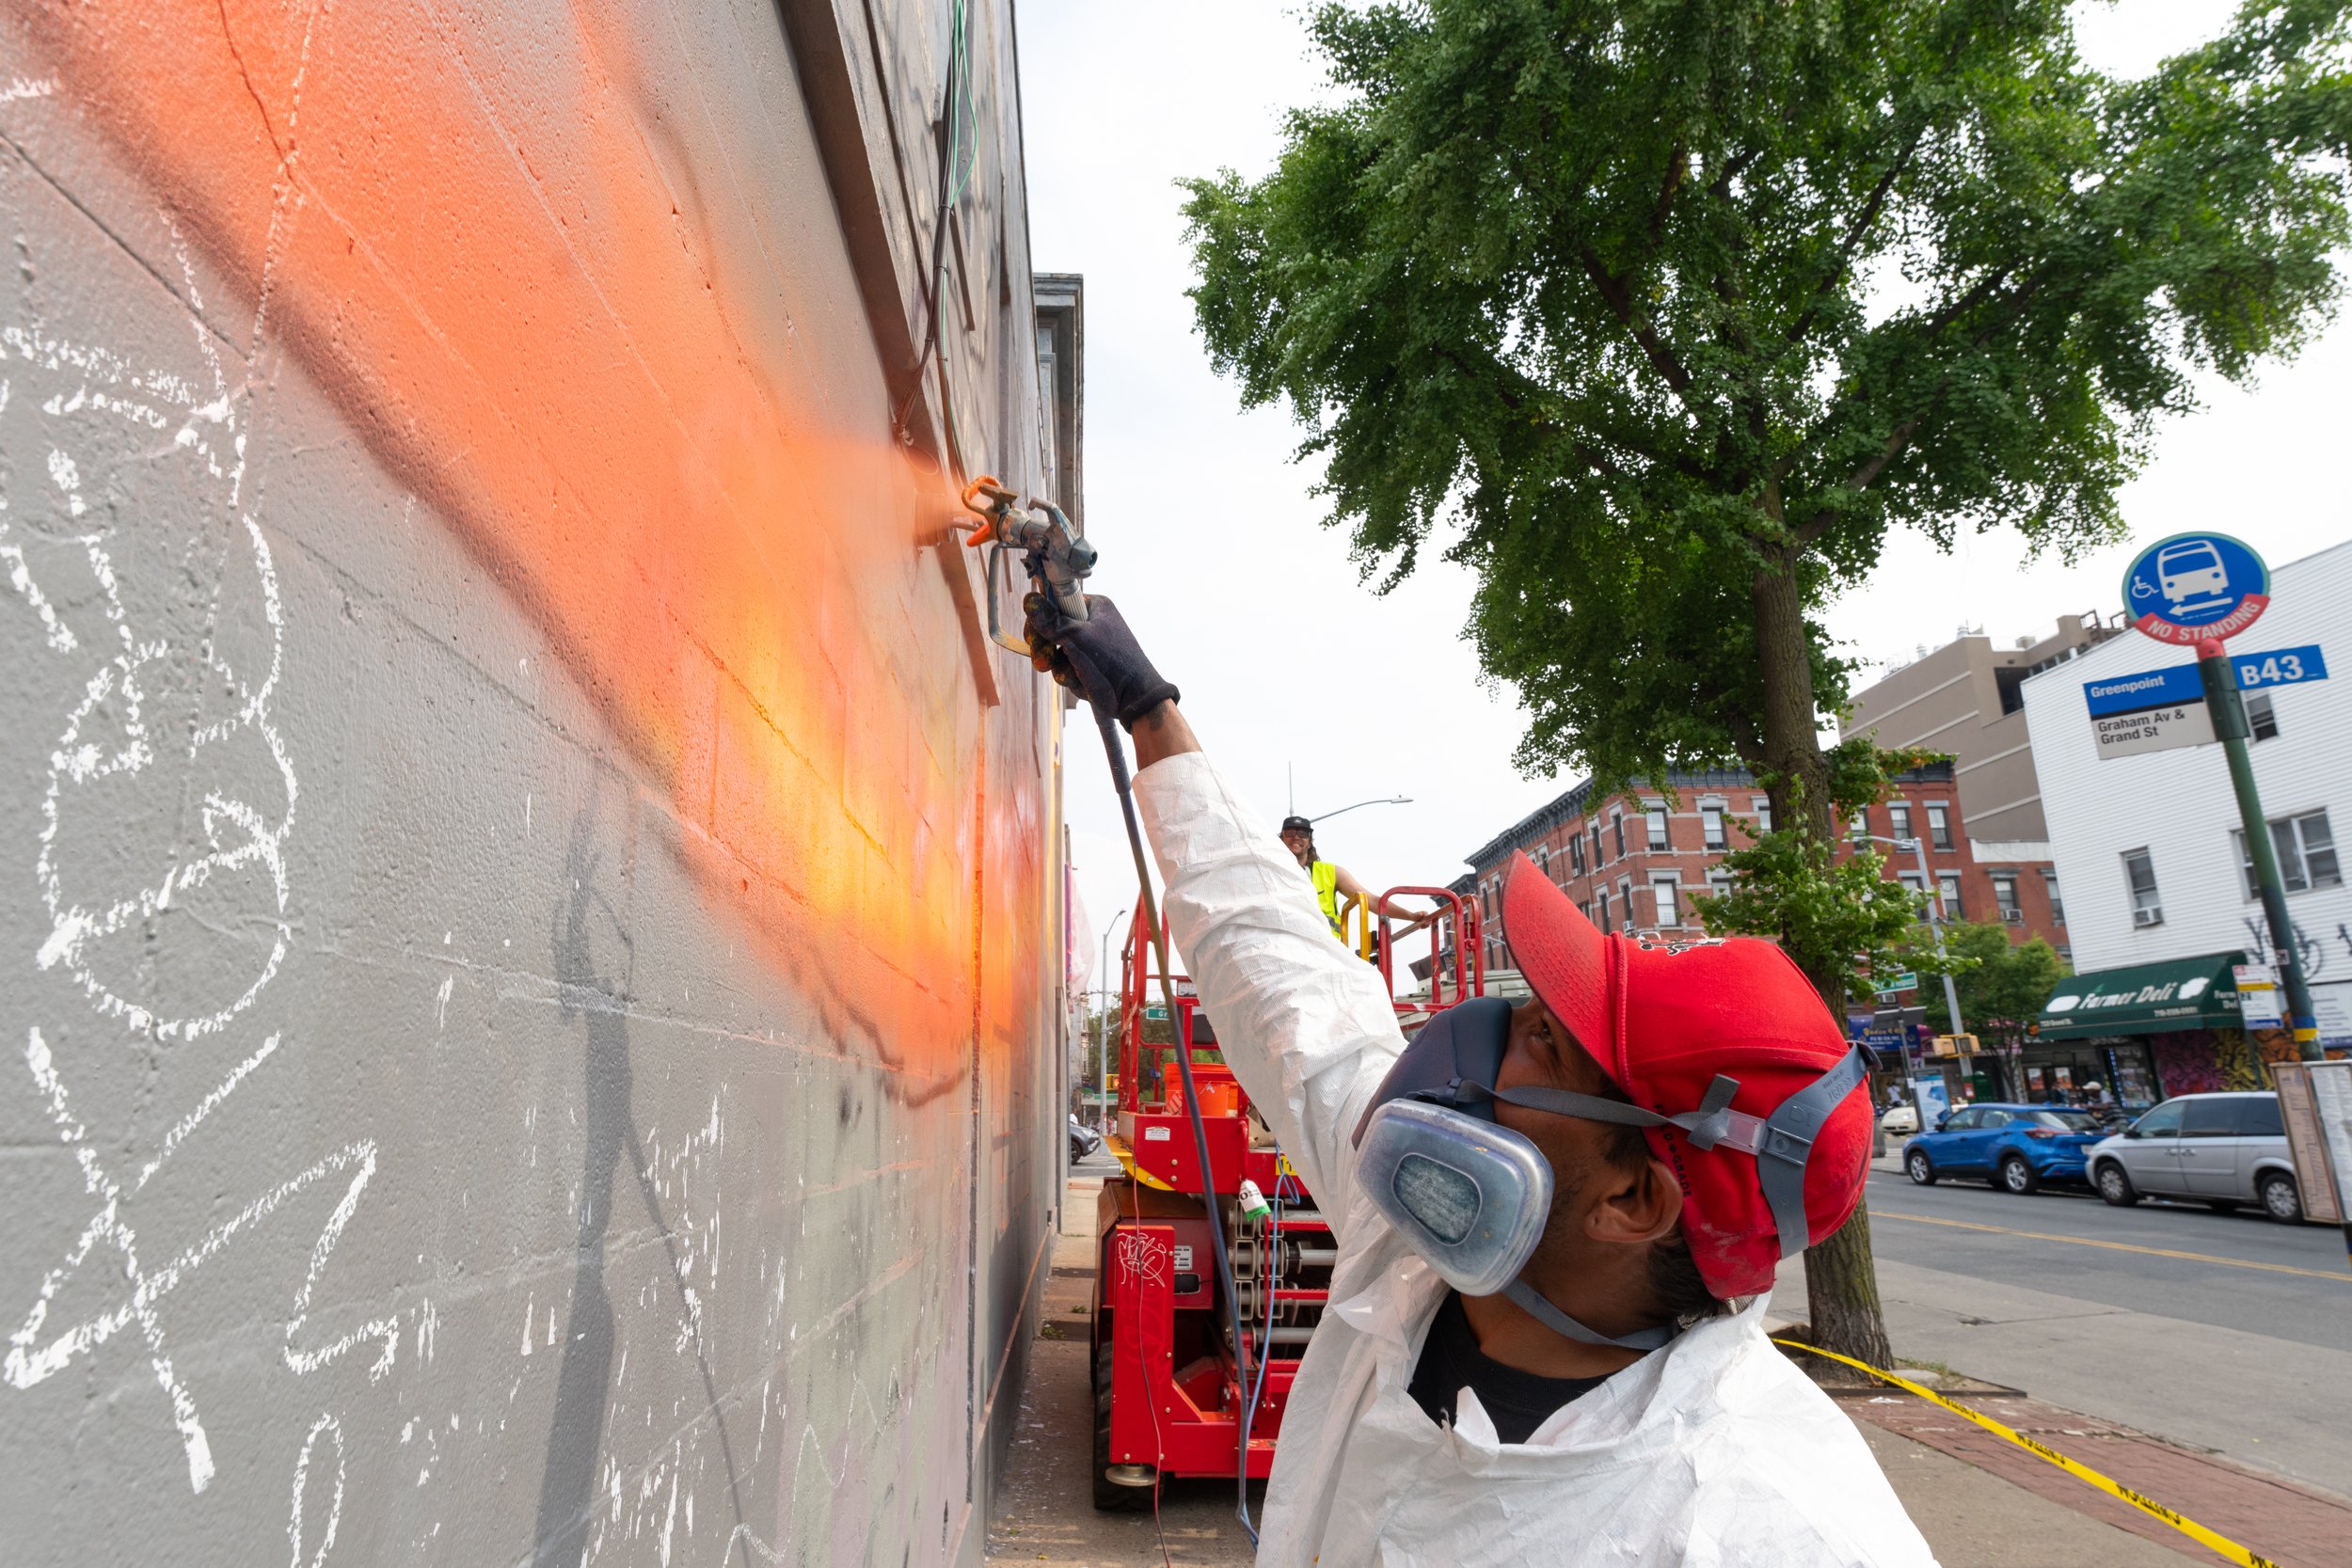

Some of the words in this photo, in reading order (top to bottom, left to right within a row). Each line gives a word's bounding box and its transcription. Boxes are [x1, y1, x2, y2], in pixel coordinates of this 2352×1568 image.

[2147, 621, 2172, 638] NO
[2178, 601, 2261, 641] STANDING
[2240, 655, 2304, 686] B43
[2090, 675, 2165, 697] Greenpoint
[2098, 716, 2150, 732] Graham
[2154, 712, 2170, 723] Av
[2174, 708, 2185, 720] &
[2101, 729, 2140, 745] Grand
[2143, 725, 2159, 737] St
[2078, 991, 2137, 1009] Farmer
[2135, 981, 2178, 1004] Deli
[1673, 1154, 1692, 1197] GRADE
